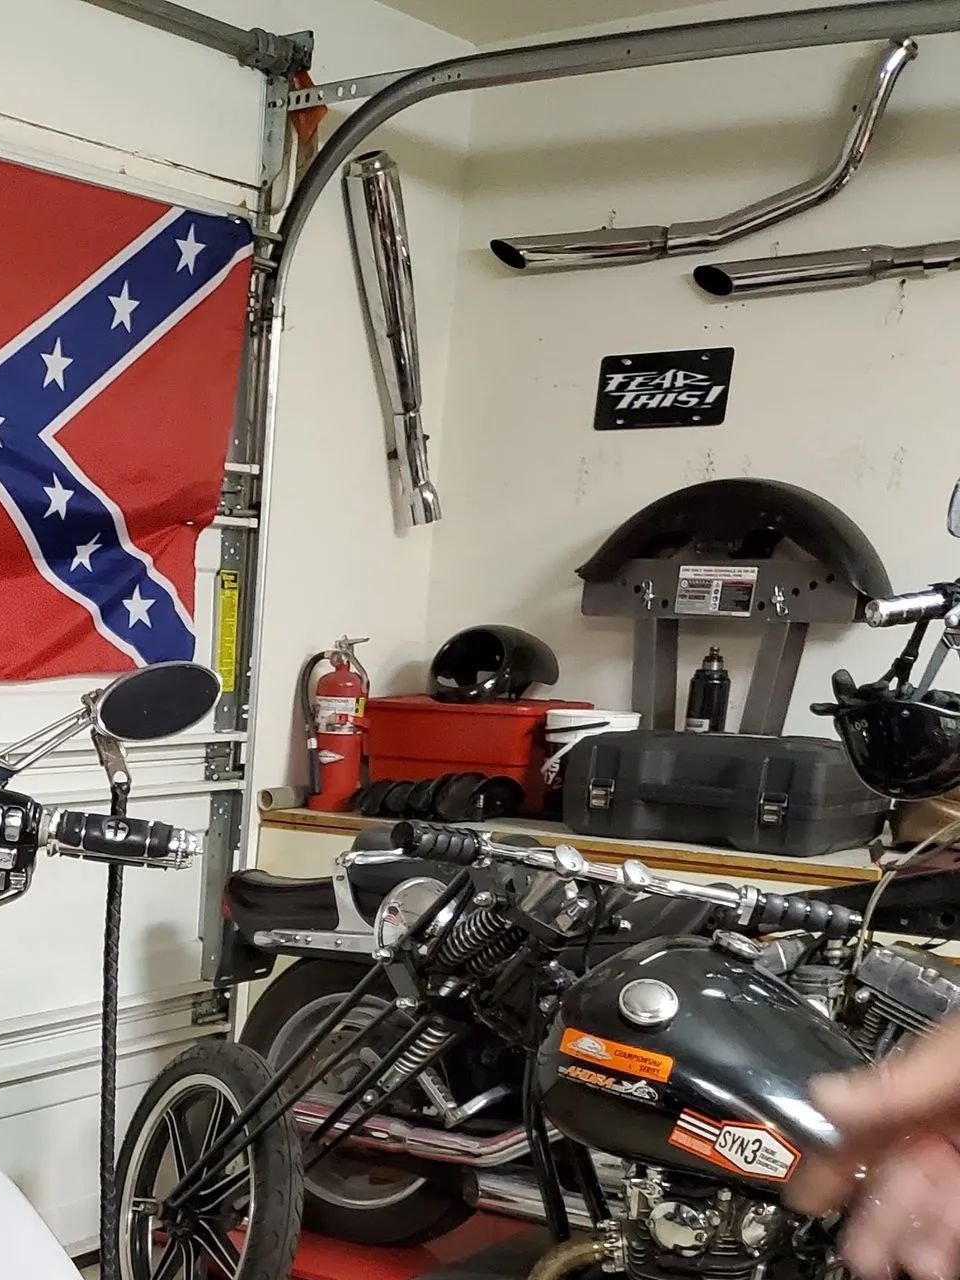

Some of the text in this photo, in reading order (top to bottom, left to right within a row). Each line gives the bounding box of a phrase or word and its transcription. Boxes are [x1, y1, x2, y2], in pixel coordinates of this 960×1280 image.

[605, 369, 711, 391] FEAR
[609, 385, 726, 409] THIS!
[719, 1130, 763, 1165] SYN3
